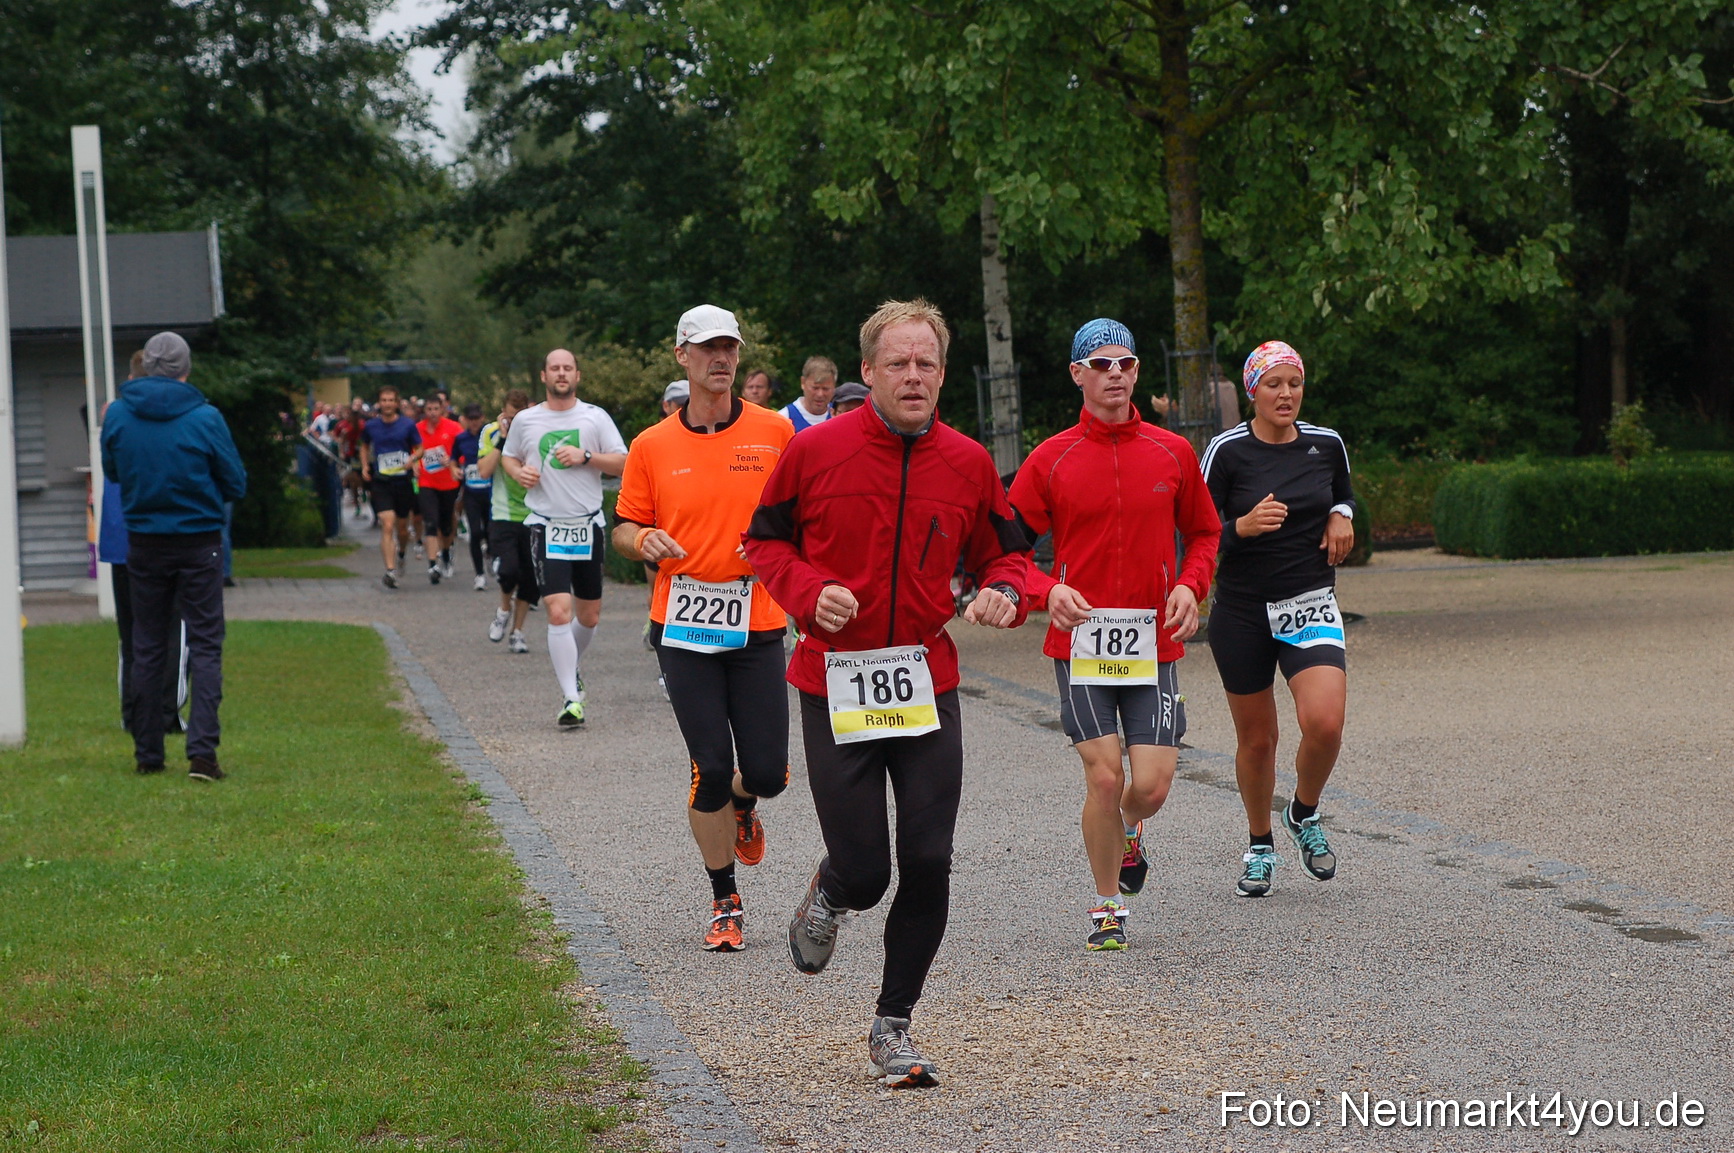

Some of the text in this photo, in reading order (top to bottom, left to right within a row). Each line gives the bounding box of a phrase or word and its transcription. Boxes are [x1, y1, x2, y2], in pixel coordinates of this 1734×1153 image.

[735, 454, 760, 462] Team
[729, 464, 764, 472] heba-tec
[551, 526, 588, 543] 2750
[672, 582, 737, 595] PARTL Neumarkt
[675, 594, 743, 627] 2220
[1268, 602, 1294, 611] PARTL
[1086, 616, 1142, 624] RTL Neumarkt
[1277, 604, 1336, 634] 2626
[686, 630, 725, 644] Helmut
[1090, 627, 1140, 656] 182
[862, 653, 911, 667] Neumarkt
[1098, 663, 1130, 675] Heiko
[849, 667, 914, 705] 186
[865, 713, 905, 728] Ralph
